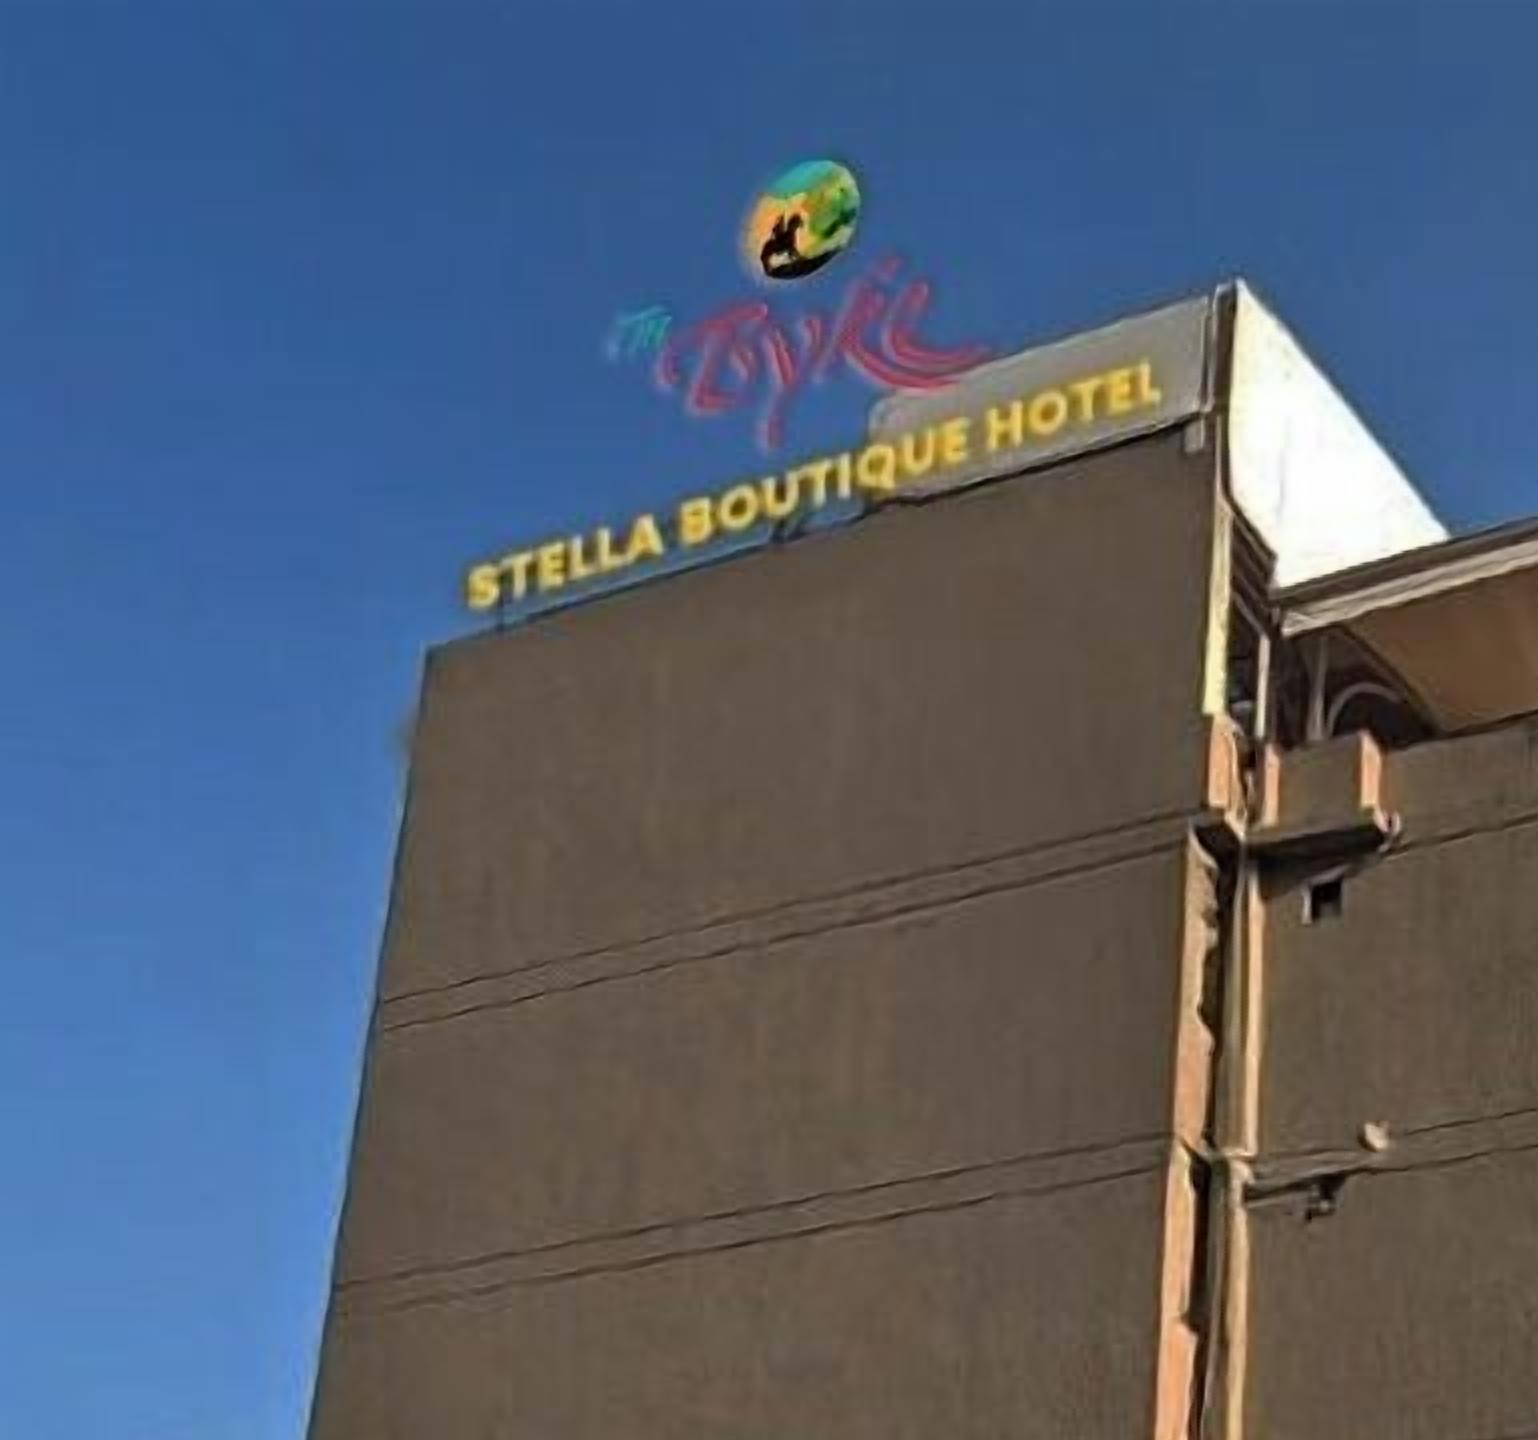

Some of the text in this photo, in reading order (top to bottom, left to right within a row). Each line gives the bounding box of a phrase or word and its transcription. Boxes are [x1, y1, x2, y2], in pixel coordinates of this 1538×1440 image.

[466, 361, 1164, 610] STELLA BOUTIQUE HOTEL
